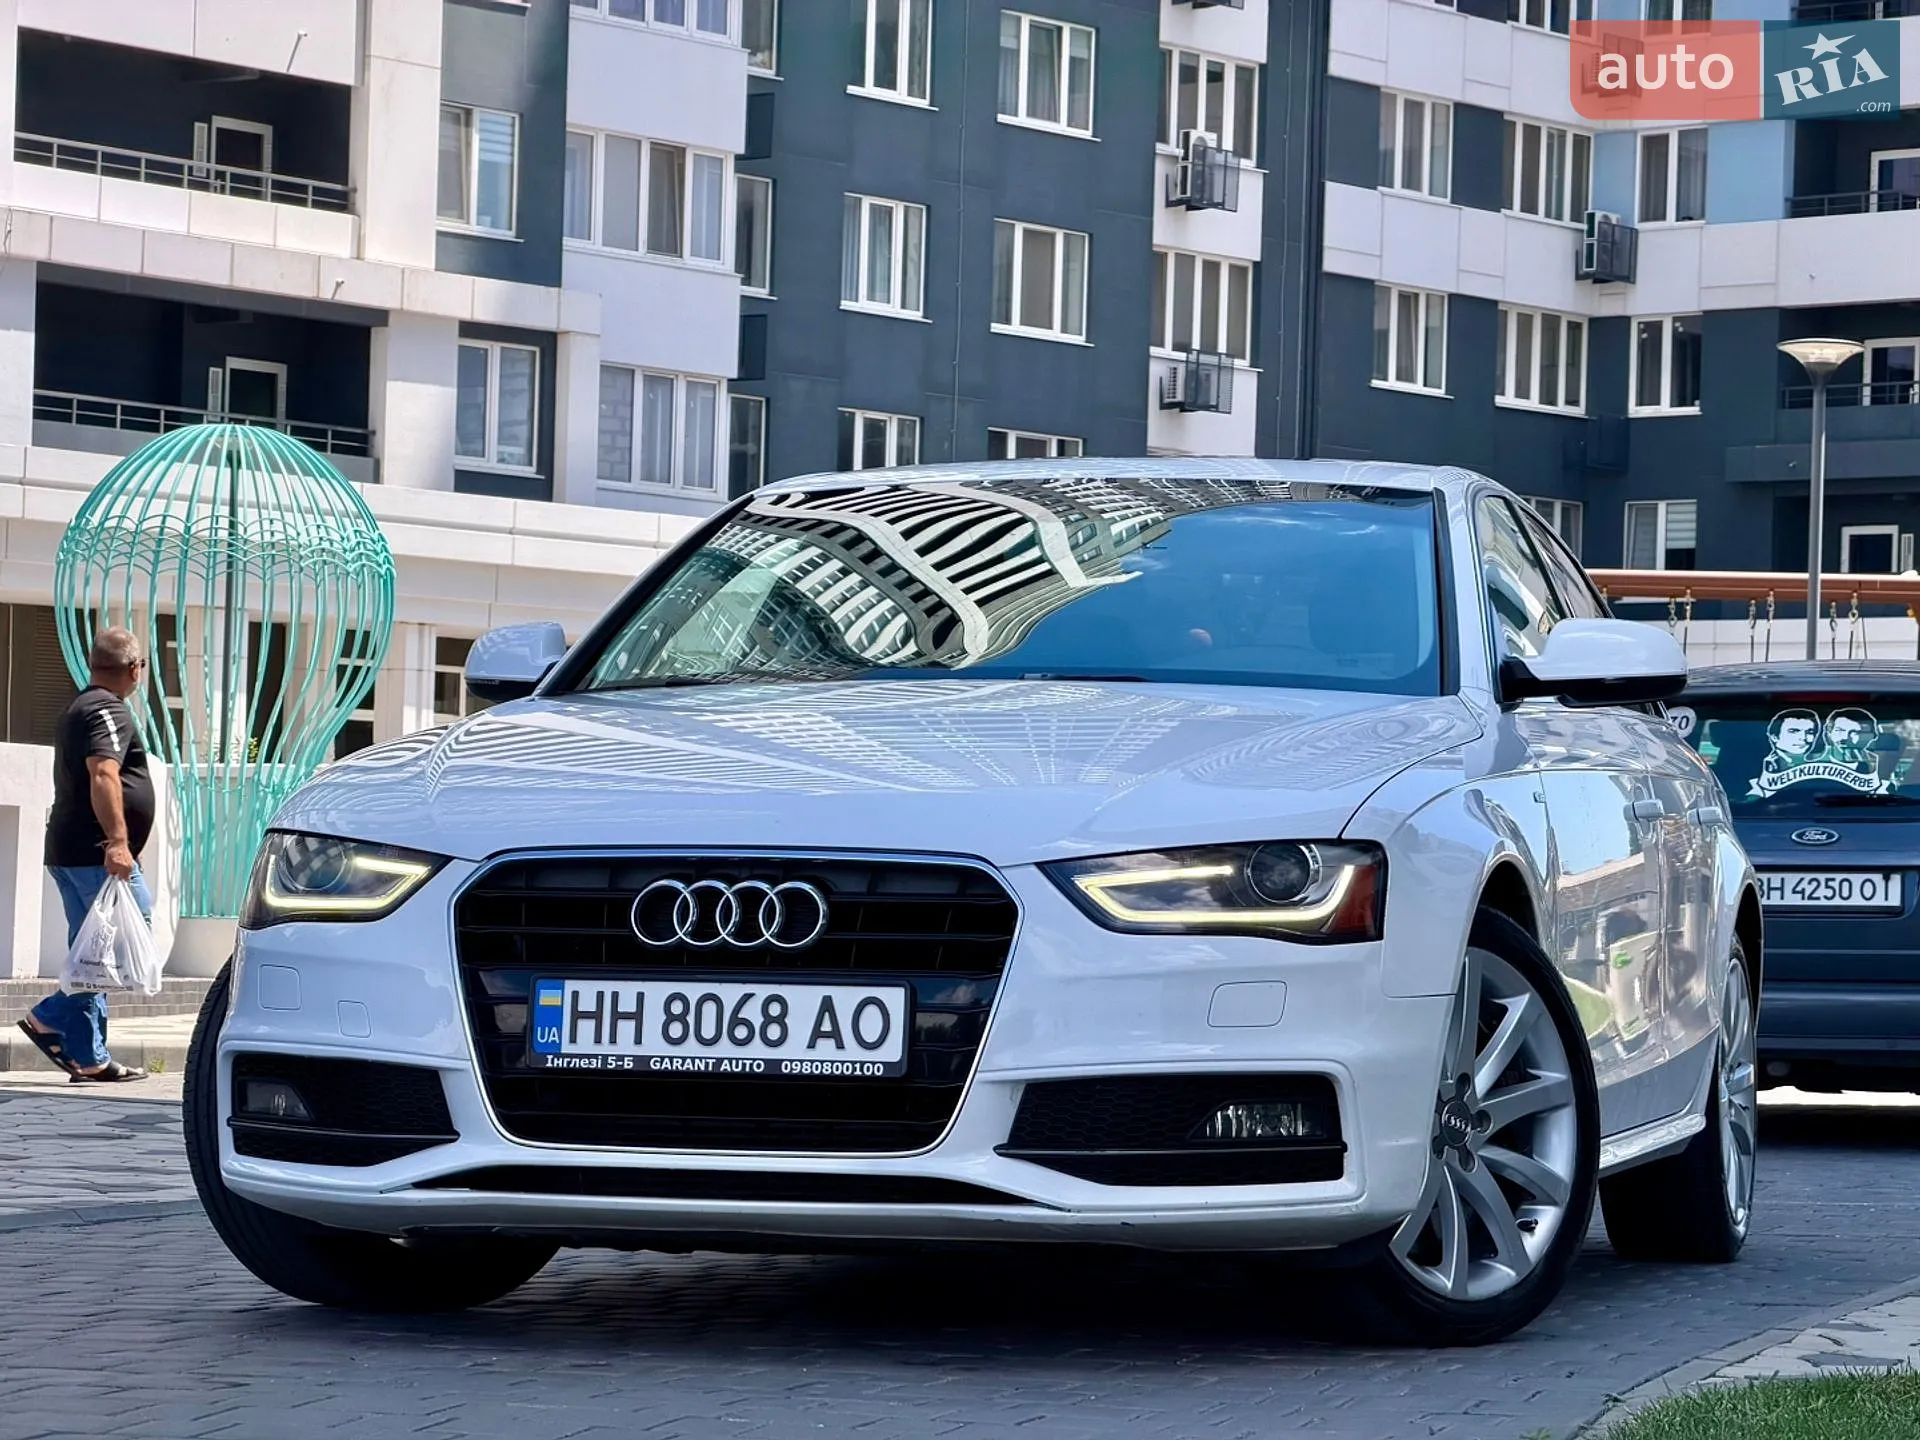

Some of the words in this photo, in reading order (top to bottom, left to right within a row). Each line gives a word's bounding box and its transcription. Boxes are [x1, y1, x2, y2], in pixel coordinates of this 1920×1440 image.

[1766, 765, 1874, 788] WELTKULTURERBE
[1802, 830, 1828, 841] Ford
[1791, 877, 1853, 901] 4250
[568, 990, 645, 1045] HH
[661, 991, 789, 1048] 8068
[806, 994, 891, 1051] AO
[536, 1026, 560, 1044] UA
[545, 1054, 603, 1071] Інглезі
[607, 1056, 634, 1070] 5-Б
[649, 1056, 717, 1072] GARANT
[720, 1058, 765, 1073] AUTO
[781, 1060, 884, 1076] 0980800100
